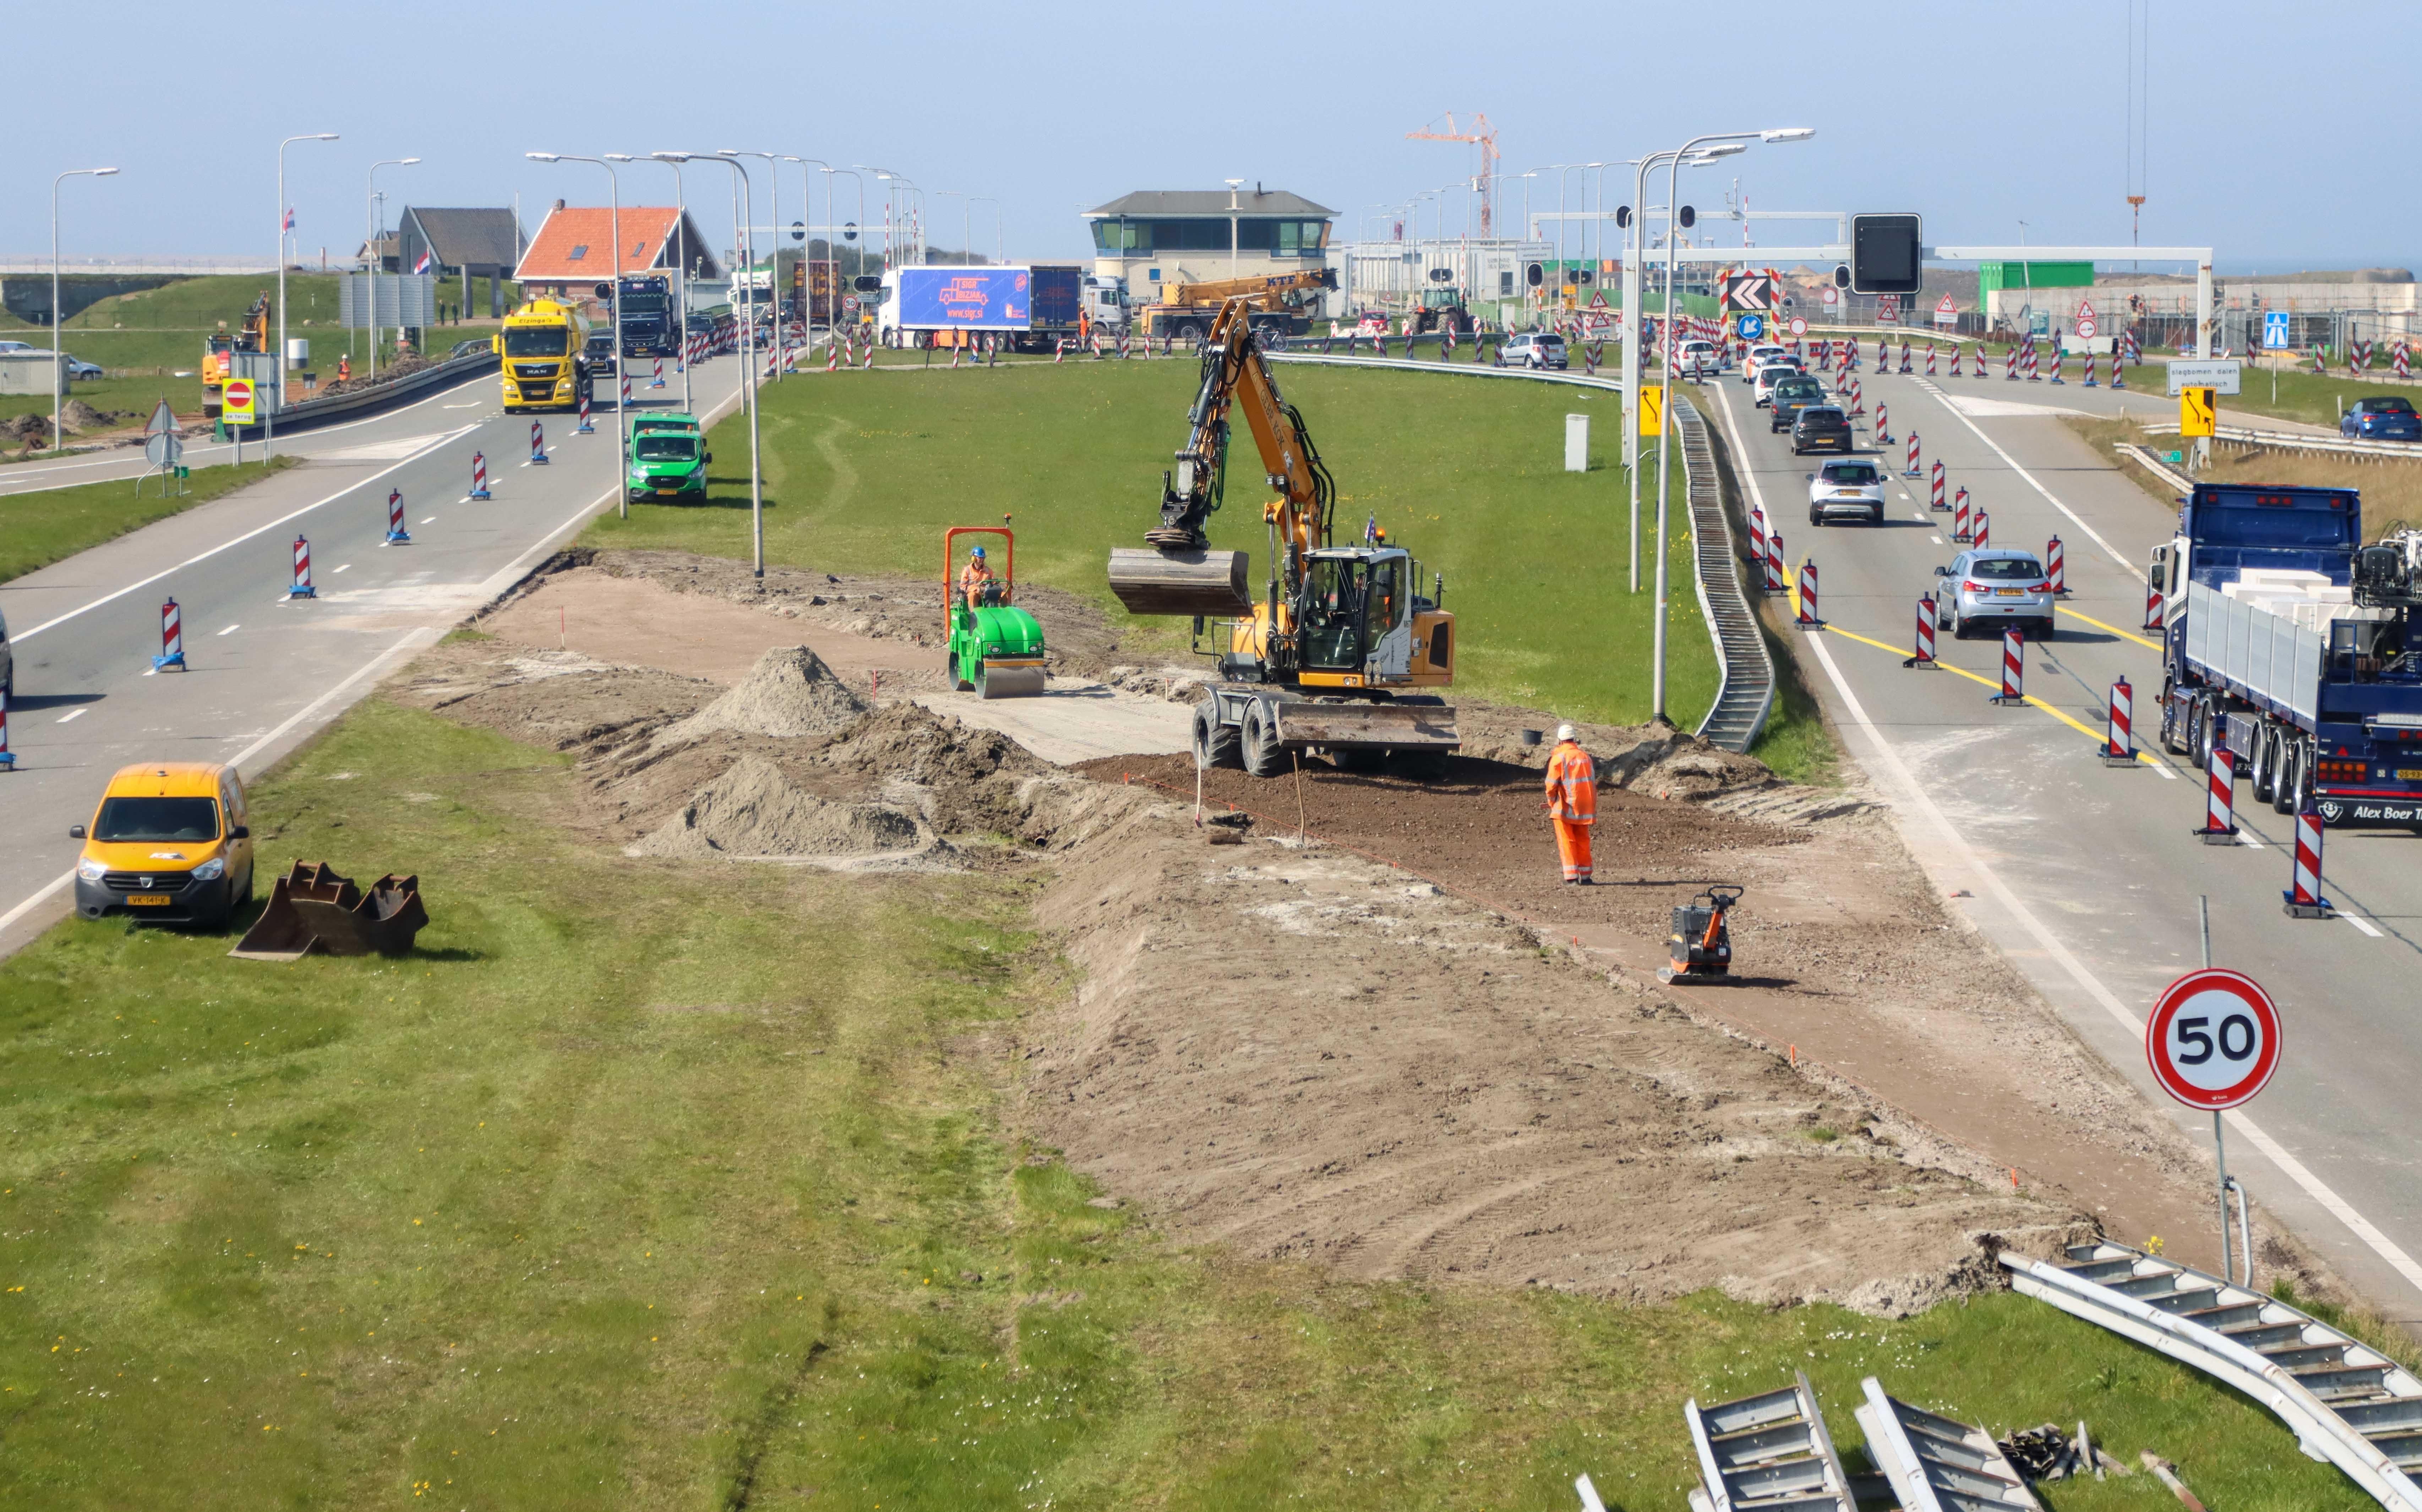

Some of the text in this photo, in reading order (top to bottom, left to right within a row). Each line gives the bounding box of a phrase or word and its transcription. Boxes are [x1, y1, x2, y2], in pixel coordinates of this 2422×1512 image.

[1267, 275, 1295, 286] KTF
[947, 308, 983, 321] www.sigr.si
[1273, 420, 1284, 450] KOK
[2354, 806, 2381, 818] Alex
[2383, 807, 2413, 820] Boer
[2178, 1014, 2255, 1065] 50
